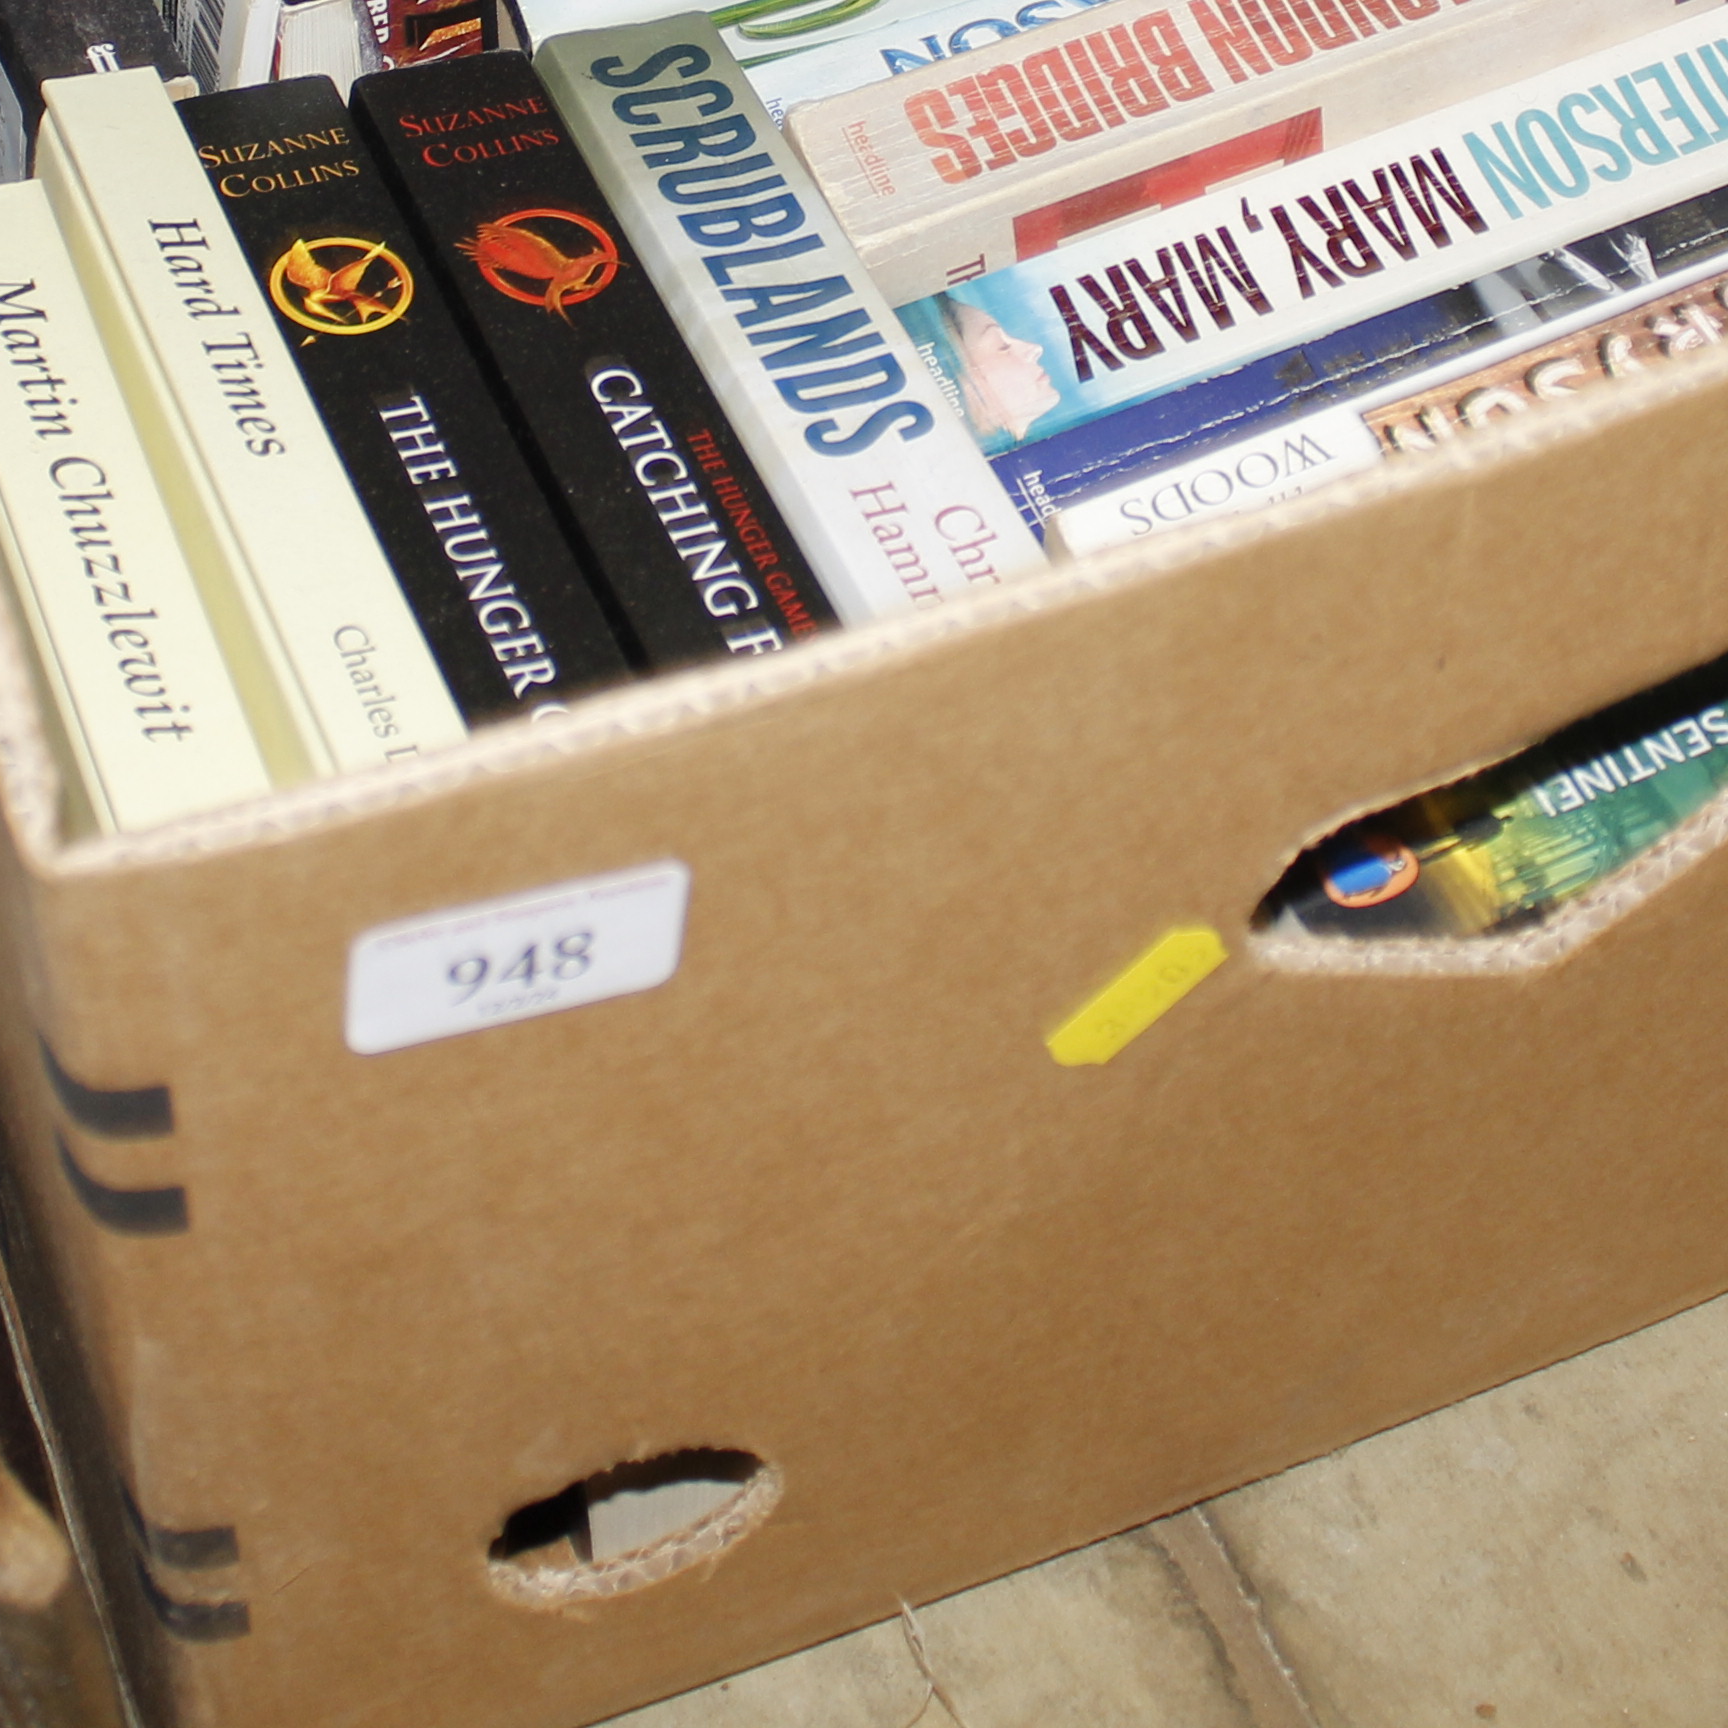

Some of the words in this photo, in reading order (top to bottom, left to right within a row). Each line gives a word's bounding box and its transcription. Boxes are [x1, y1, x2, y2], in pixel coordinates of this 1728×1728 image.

[197, 125, 353, 171] SUZANNE
[397, 94, 552, 141] SUZANNE
[420, 125, 563, 171] COLLINS
[849, 120, 897, 198] headline
[902, 7, 1217, 186] BRIDGES
[217, 157, 363, 200] COLLINS
[588, 41, 937, 459] SCRUBLANDS
[1239, 147, 1490, 301] MARY,
[147, 215, 242, 322] Hard
[201, 330, 287, 459] Times
[1047, 224, 1275, 385] MARY
[376, 392, 459, 486] THE
[422, 492, 559, 700] HUNGER
[588, 365, 763, 621] CATCHING
[686, 427, 729, 473] THE
[711, 475, 781, 572] HUNGER
[763, 570, 821, 645] GAME
[1119, 432, 1338, 537] WOODS
[47, 454, 195, 746] Chuzzlewit
[332, 622, 404, 742] Charles
[446, 929, 595, 1009] 948
